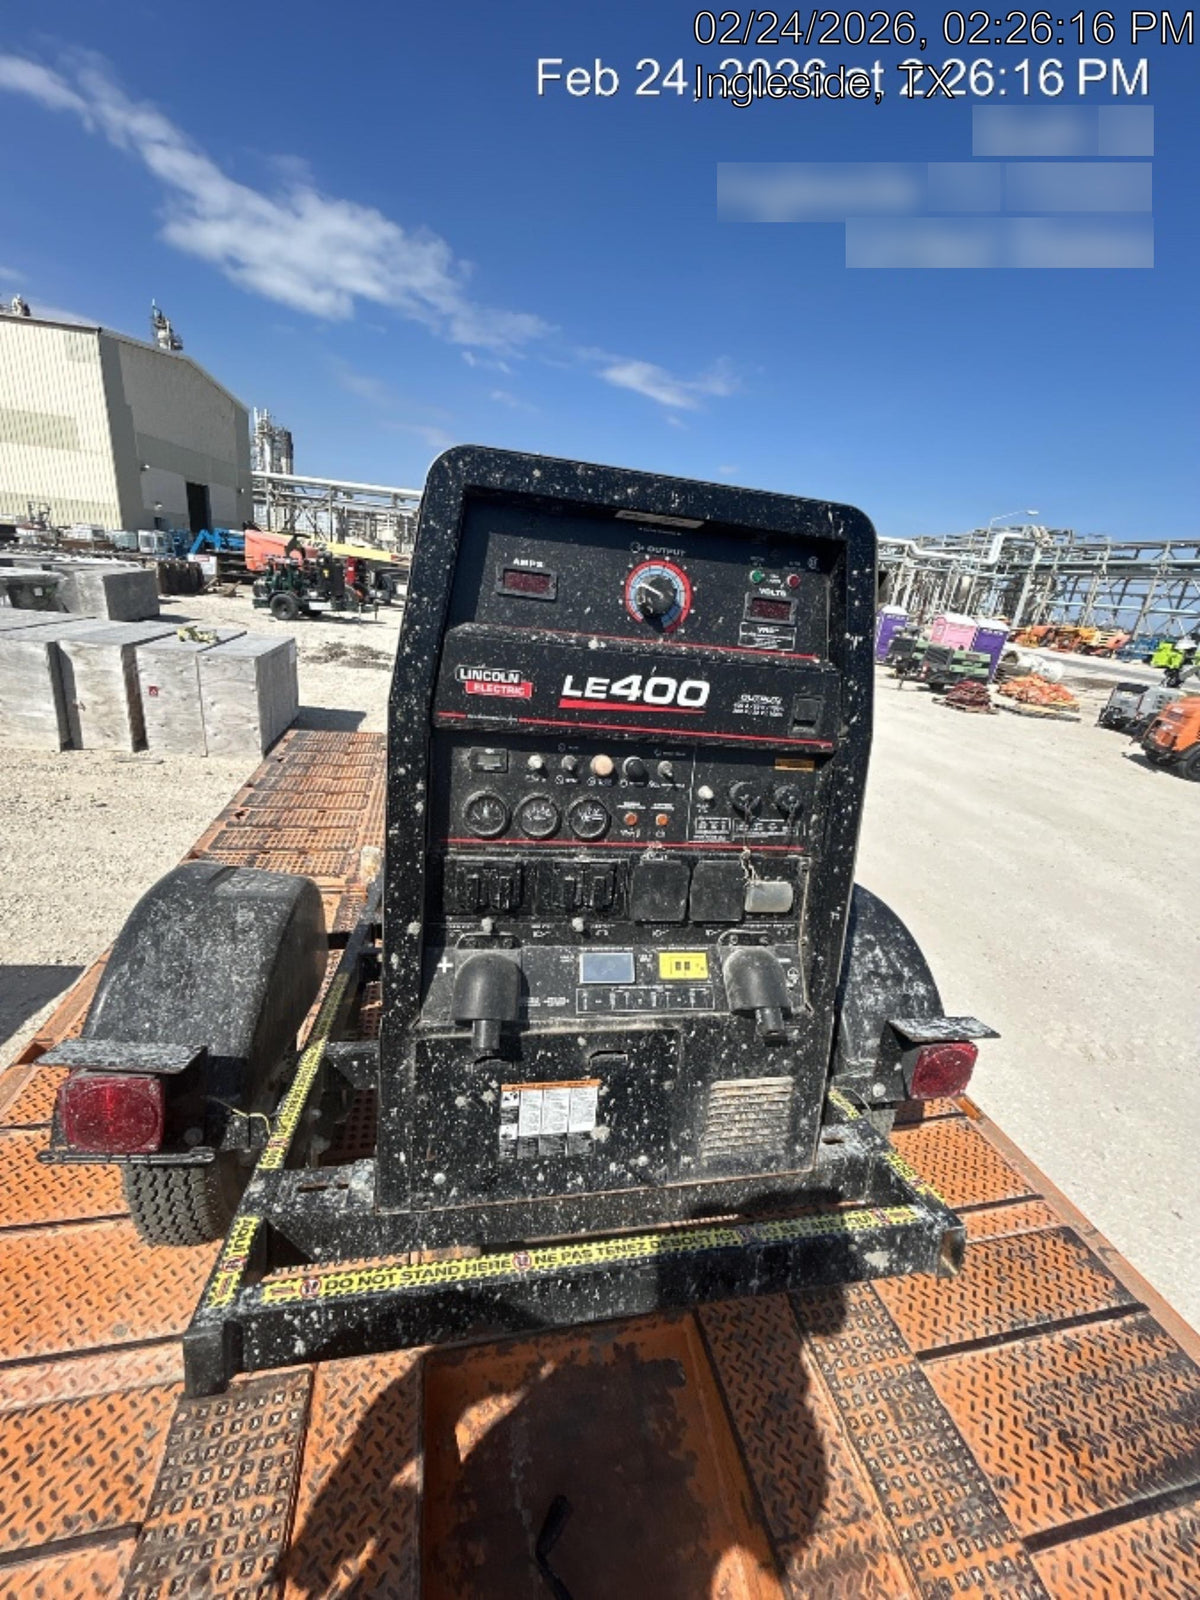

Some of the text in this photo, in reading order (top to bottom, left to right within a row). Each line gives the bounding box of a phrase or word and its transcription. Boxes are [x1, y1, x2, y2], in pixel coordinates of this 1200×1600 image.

[459, 667, 520, 684] LINCOLN
[473, 682, 525, 696] ELECTRIC
[561, 674, 711, 708] LE400
[534, 1253, 557, 1265] NE
[561, 1247, 593, 1261] PAS
[596, 1241, 648, 1256] TENEZ
[325, 1257, 512, 1290] DO NOT STAND HERE
